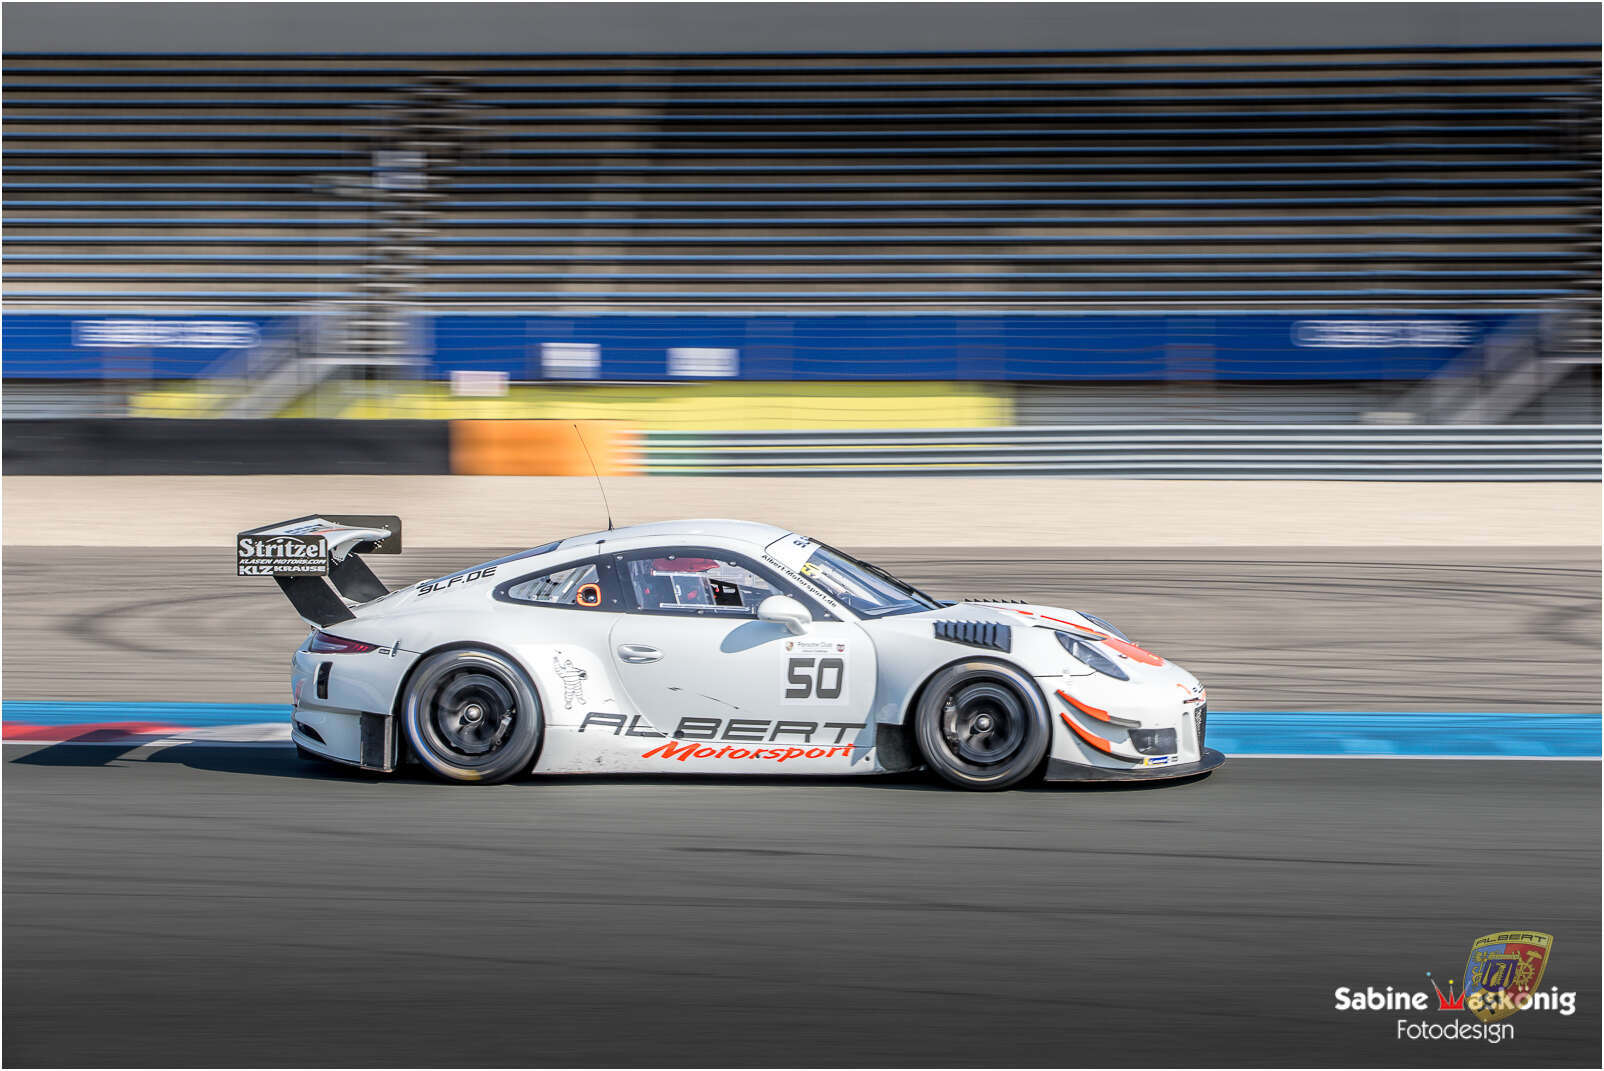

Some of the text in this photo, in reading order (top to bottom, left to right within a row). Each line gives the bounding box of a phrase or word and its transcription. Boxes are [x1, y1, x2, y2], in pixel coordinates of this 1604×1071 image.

[239, 537, 326, 558] Stritzel
[240, 565, 326, 575] KLZ KRAUSE
[416, 566, 497, 596] 9LF.DE
[784, 657, 844, 699] 50
[578, 712, 867, 744] ALBERT
[641, 741, 855, 762] Motorsport
